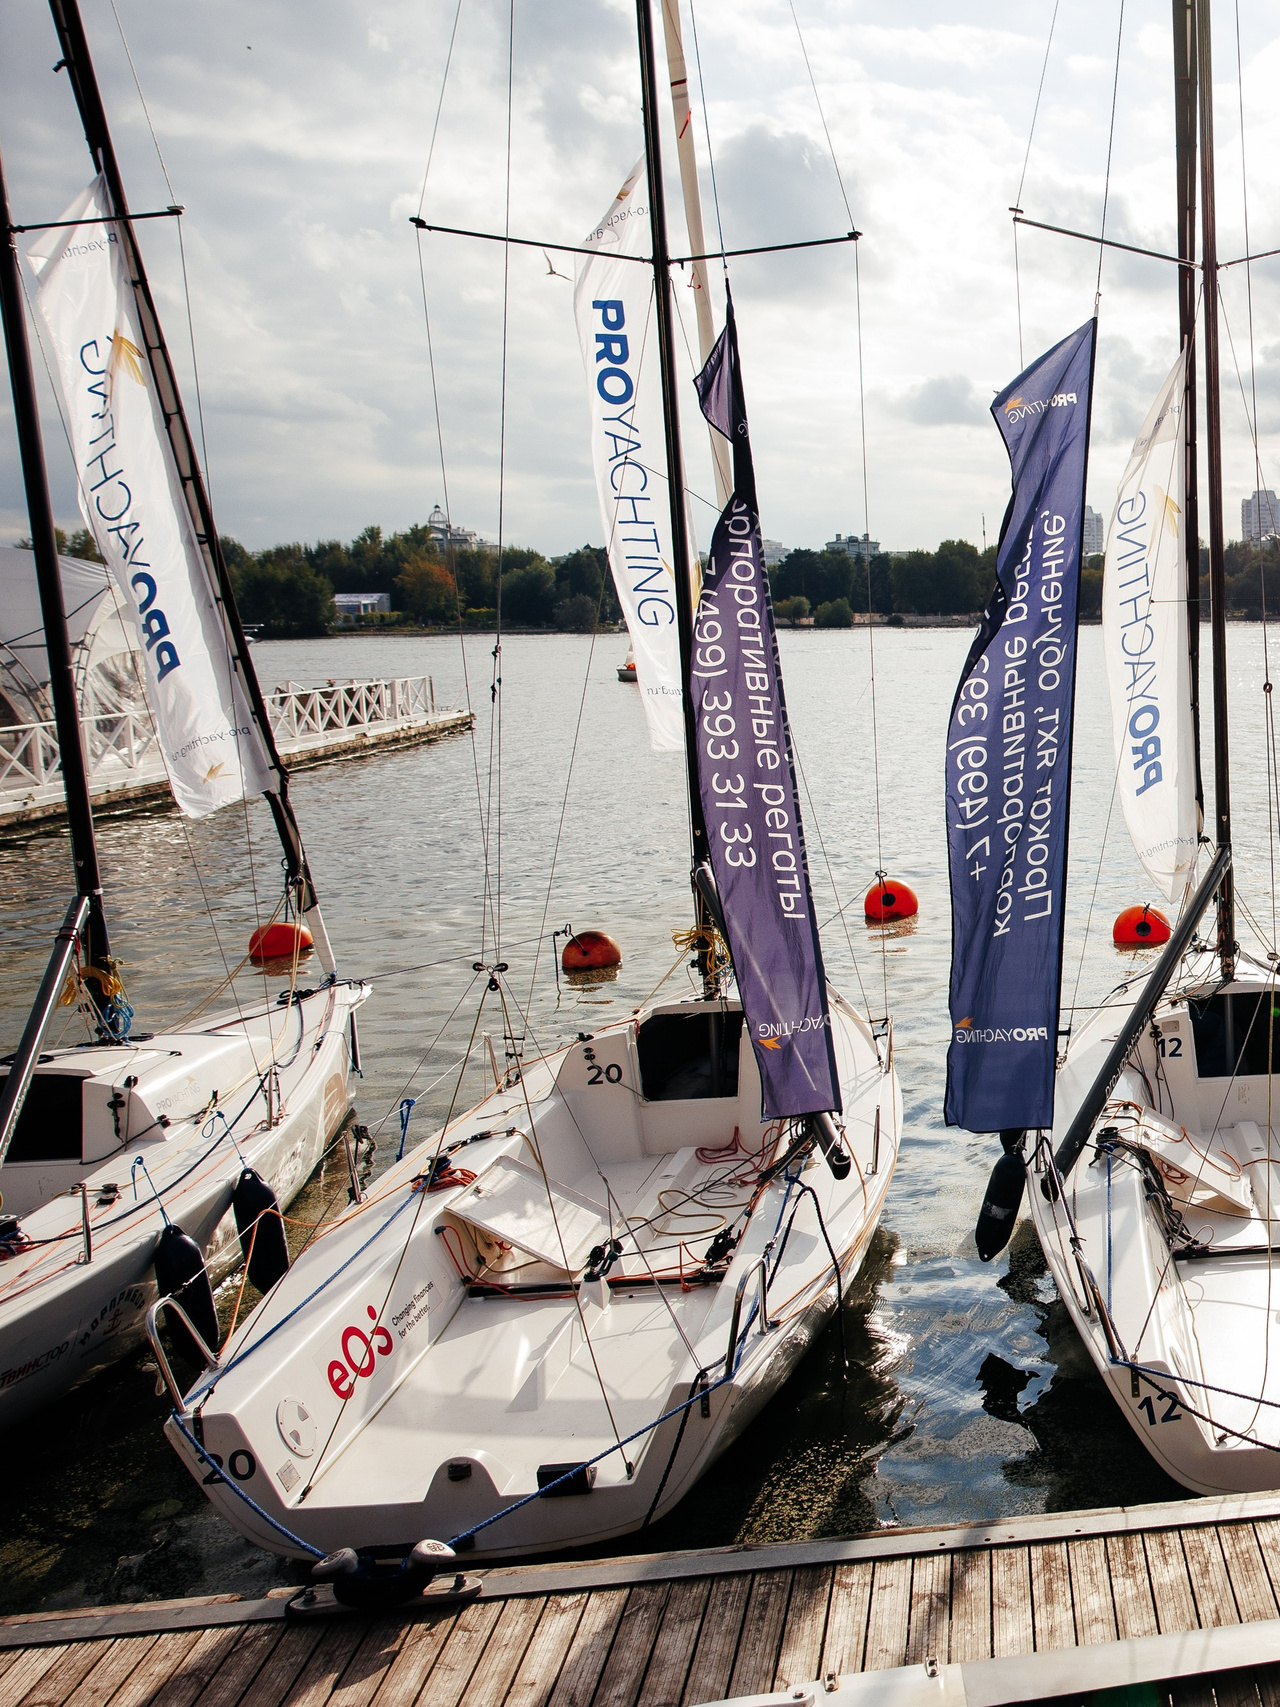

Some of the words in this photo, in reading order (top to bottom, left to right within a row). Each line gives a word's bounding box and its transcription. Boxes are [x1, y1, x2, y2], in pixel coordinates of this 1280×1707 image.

[592, 299, 674, 626] PROYACHTING
[702, 689, 739, 760] 393
[723, 499, 781, 770] орпоративные
[753, 783, 806, 919] регаты
[712, 772, 748, 809] 31
[720, 821, 756, 868] 33
[1158, 1037, 1182, 1057] 12
[587, 1064, 622, 1085] 20
[391, 1300, 417, 1326] Changing
[413, 1281, 434, 1304] finances
[1137, 1391, 1183, 1426] 12
[200, 1449, 256, 1486] 20
